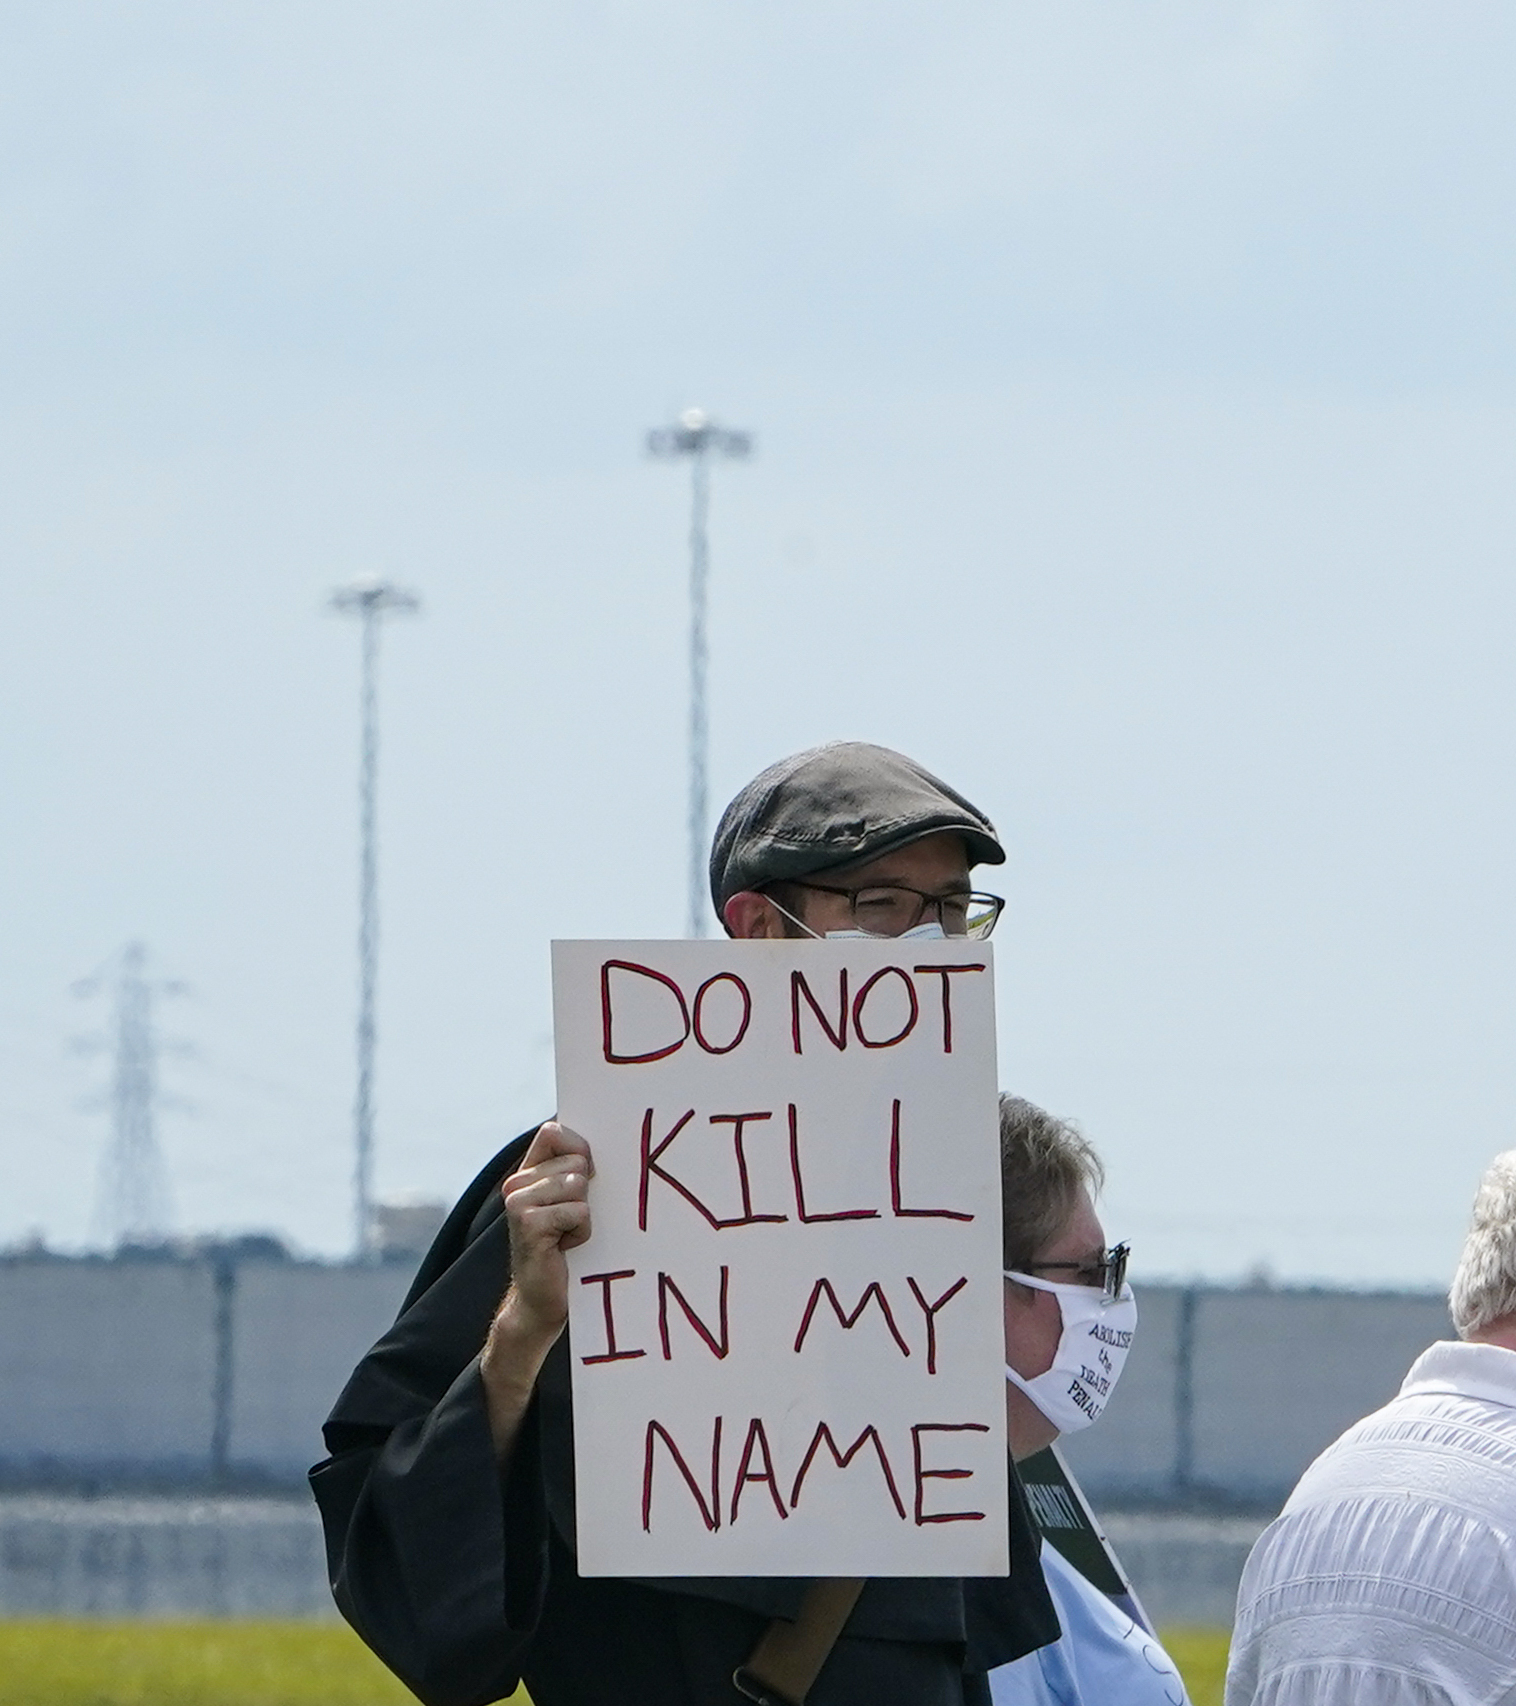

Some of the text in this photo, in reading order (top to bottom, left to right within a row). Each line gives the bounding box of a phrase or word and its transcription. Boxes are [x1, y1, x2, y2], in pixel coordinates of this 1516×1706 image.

[600, 958, 986, 1064] DO NOT
[638, 1098, 975, 1232] KILL
[580, 1265, 968, 1375] IN MY
[1098, 1347, 1113, 1375] the
[1067, 1379, 1103, 1421] PENAL
[1080, 1364, 1111, 1397] DEATH
[641, 1415, 990, 1534] NAME
